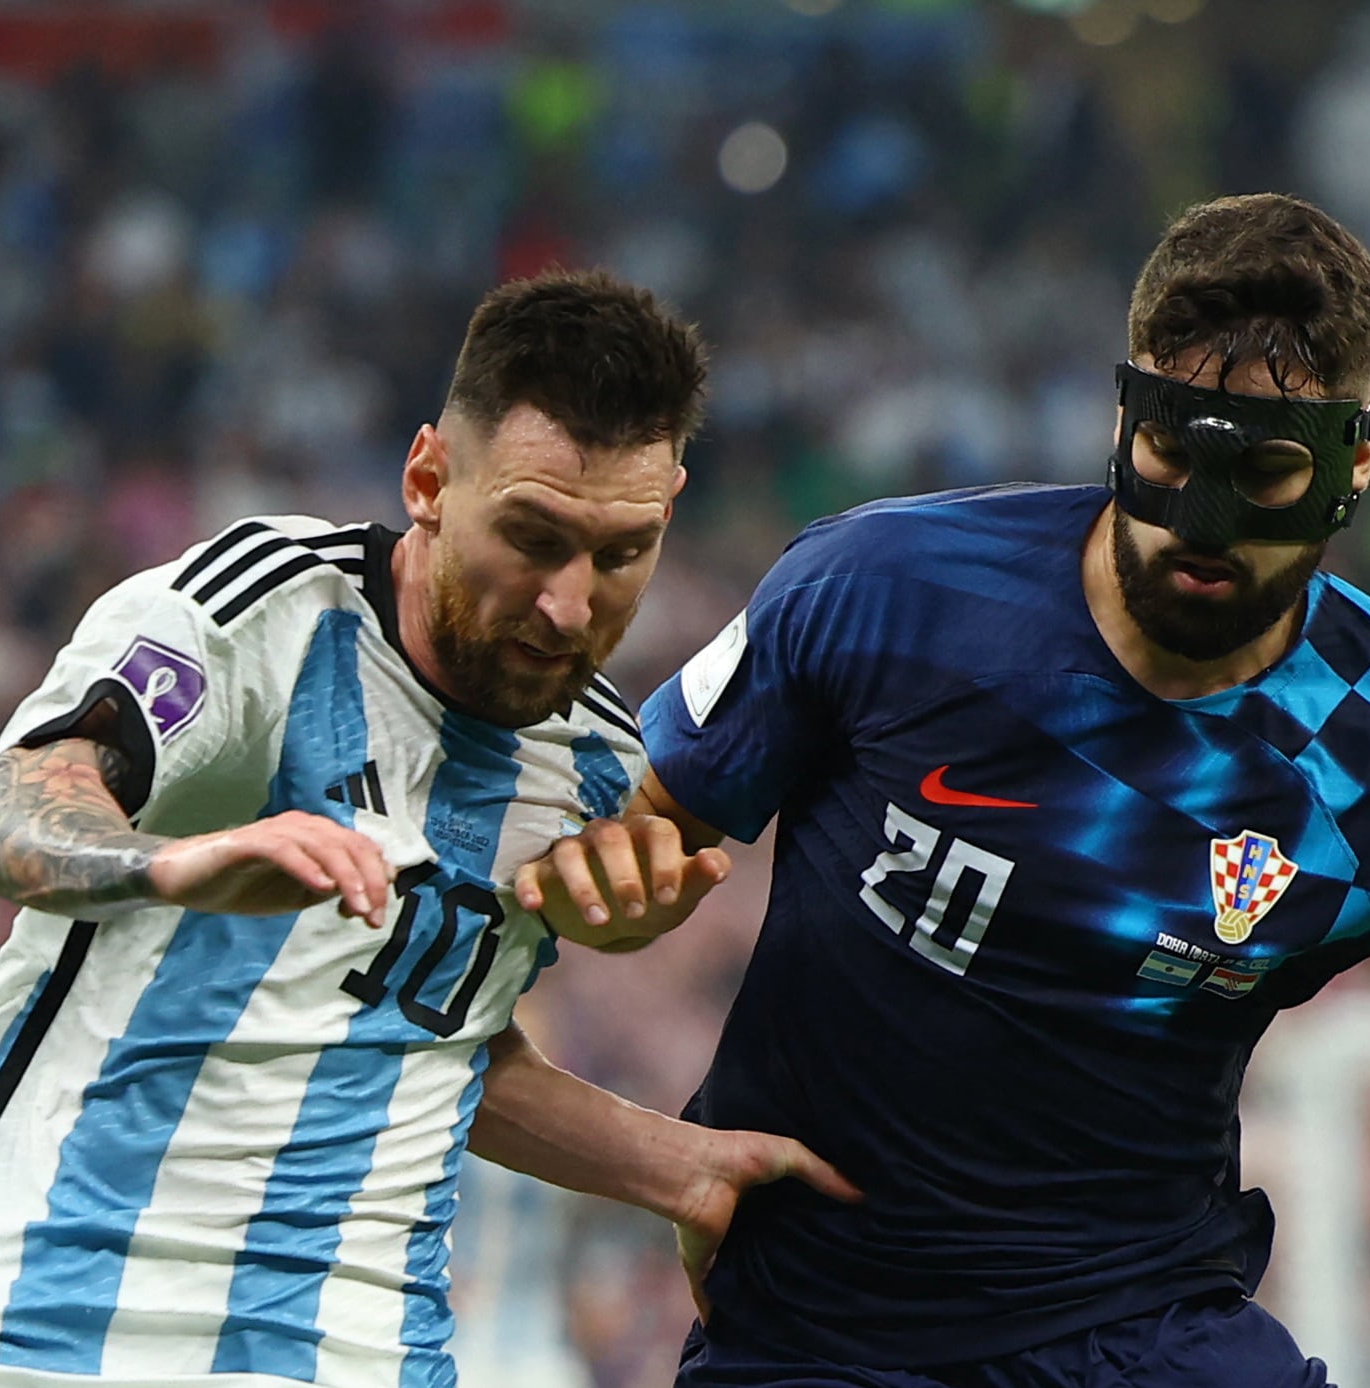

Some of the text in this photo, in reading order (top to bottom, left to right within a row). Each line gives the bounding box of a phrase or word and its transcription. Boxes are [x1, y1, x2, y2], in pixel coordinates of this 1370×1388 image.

[858, 801, 1015, 976] 20
[1238, 844, 1263, 899] HNS
[339, 860, 505, 1038] 10
[1156, 932, 1189, 955] DOHA
